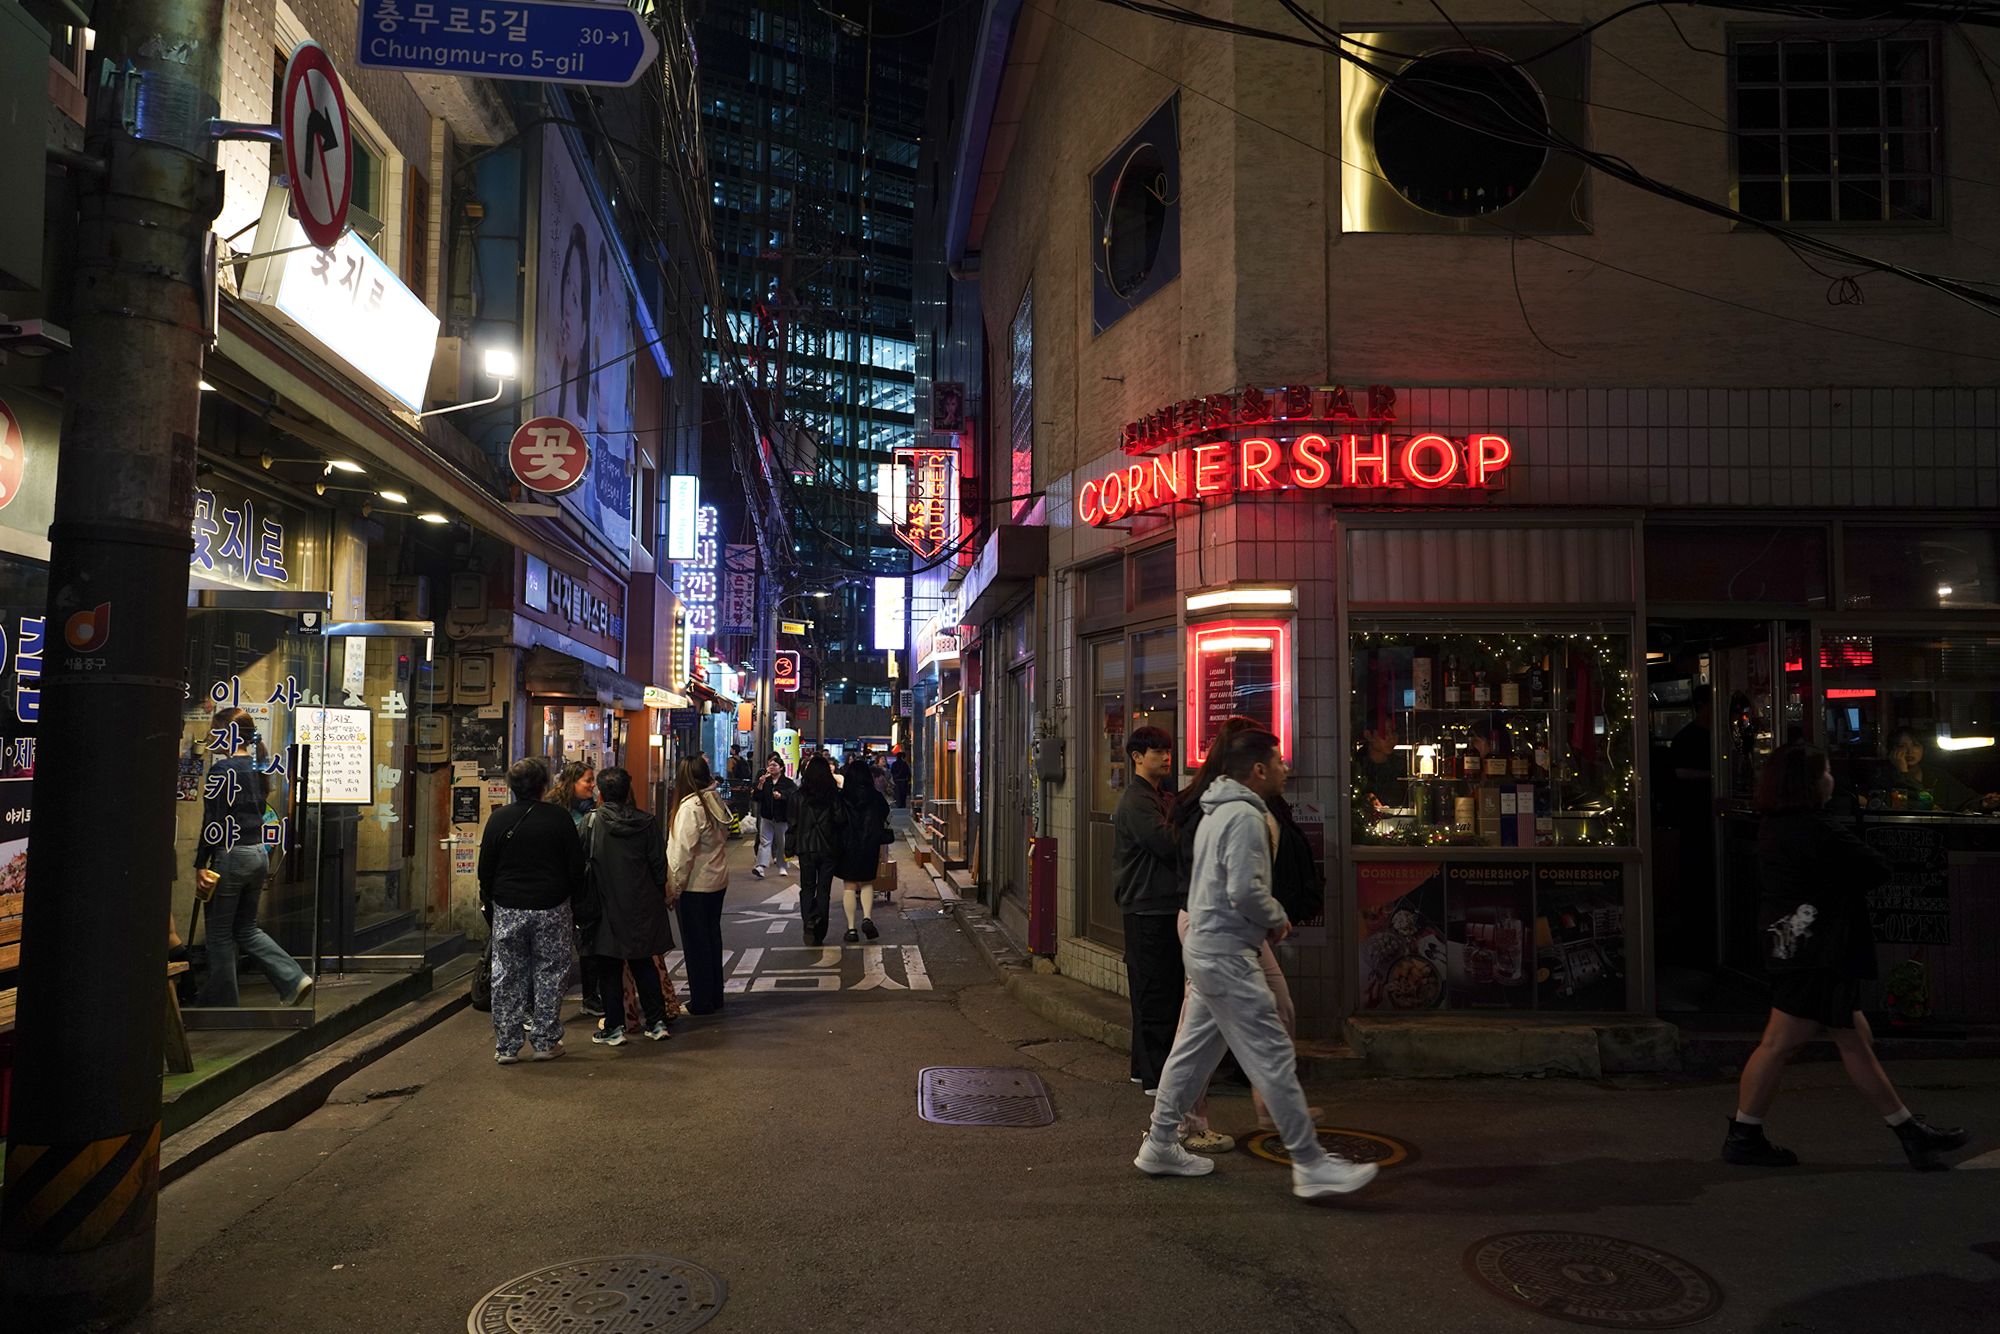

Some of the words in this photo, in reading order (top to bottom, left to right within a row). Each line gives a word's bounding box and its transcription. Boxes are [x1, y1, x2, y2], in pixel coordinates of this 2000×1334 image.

[372, 0, 529, 42] 충무로5길
[579, 27, 604, 44] 30
[369, 38, 524, 66] Chungmu-ro
[530, 49, 584, 73] 5-gil
[519, 426, 577, 481] 꽃
[1079, 432, 1512, 527] CORNERSHOP
[928, 455, 946, 541] BURGER
[63, 657, 106, 671] 서울중구
[1360, 868, 1440, 880] CORNERSHOP
[1449, 868, 1530, 880] CORNERSHOP
[1539, 868, 1620, 880] CORNERSHOP
[1884, 913, 1950, 944] OPEN
